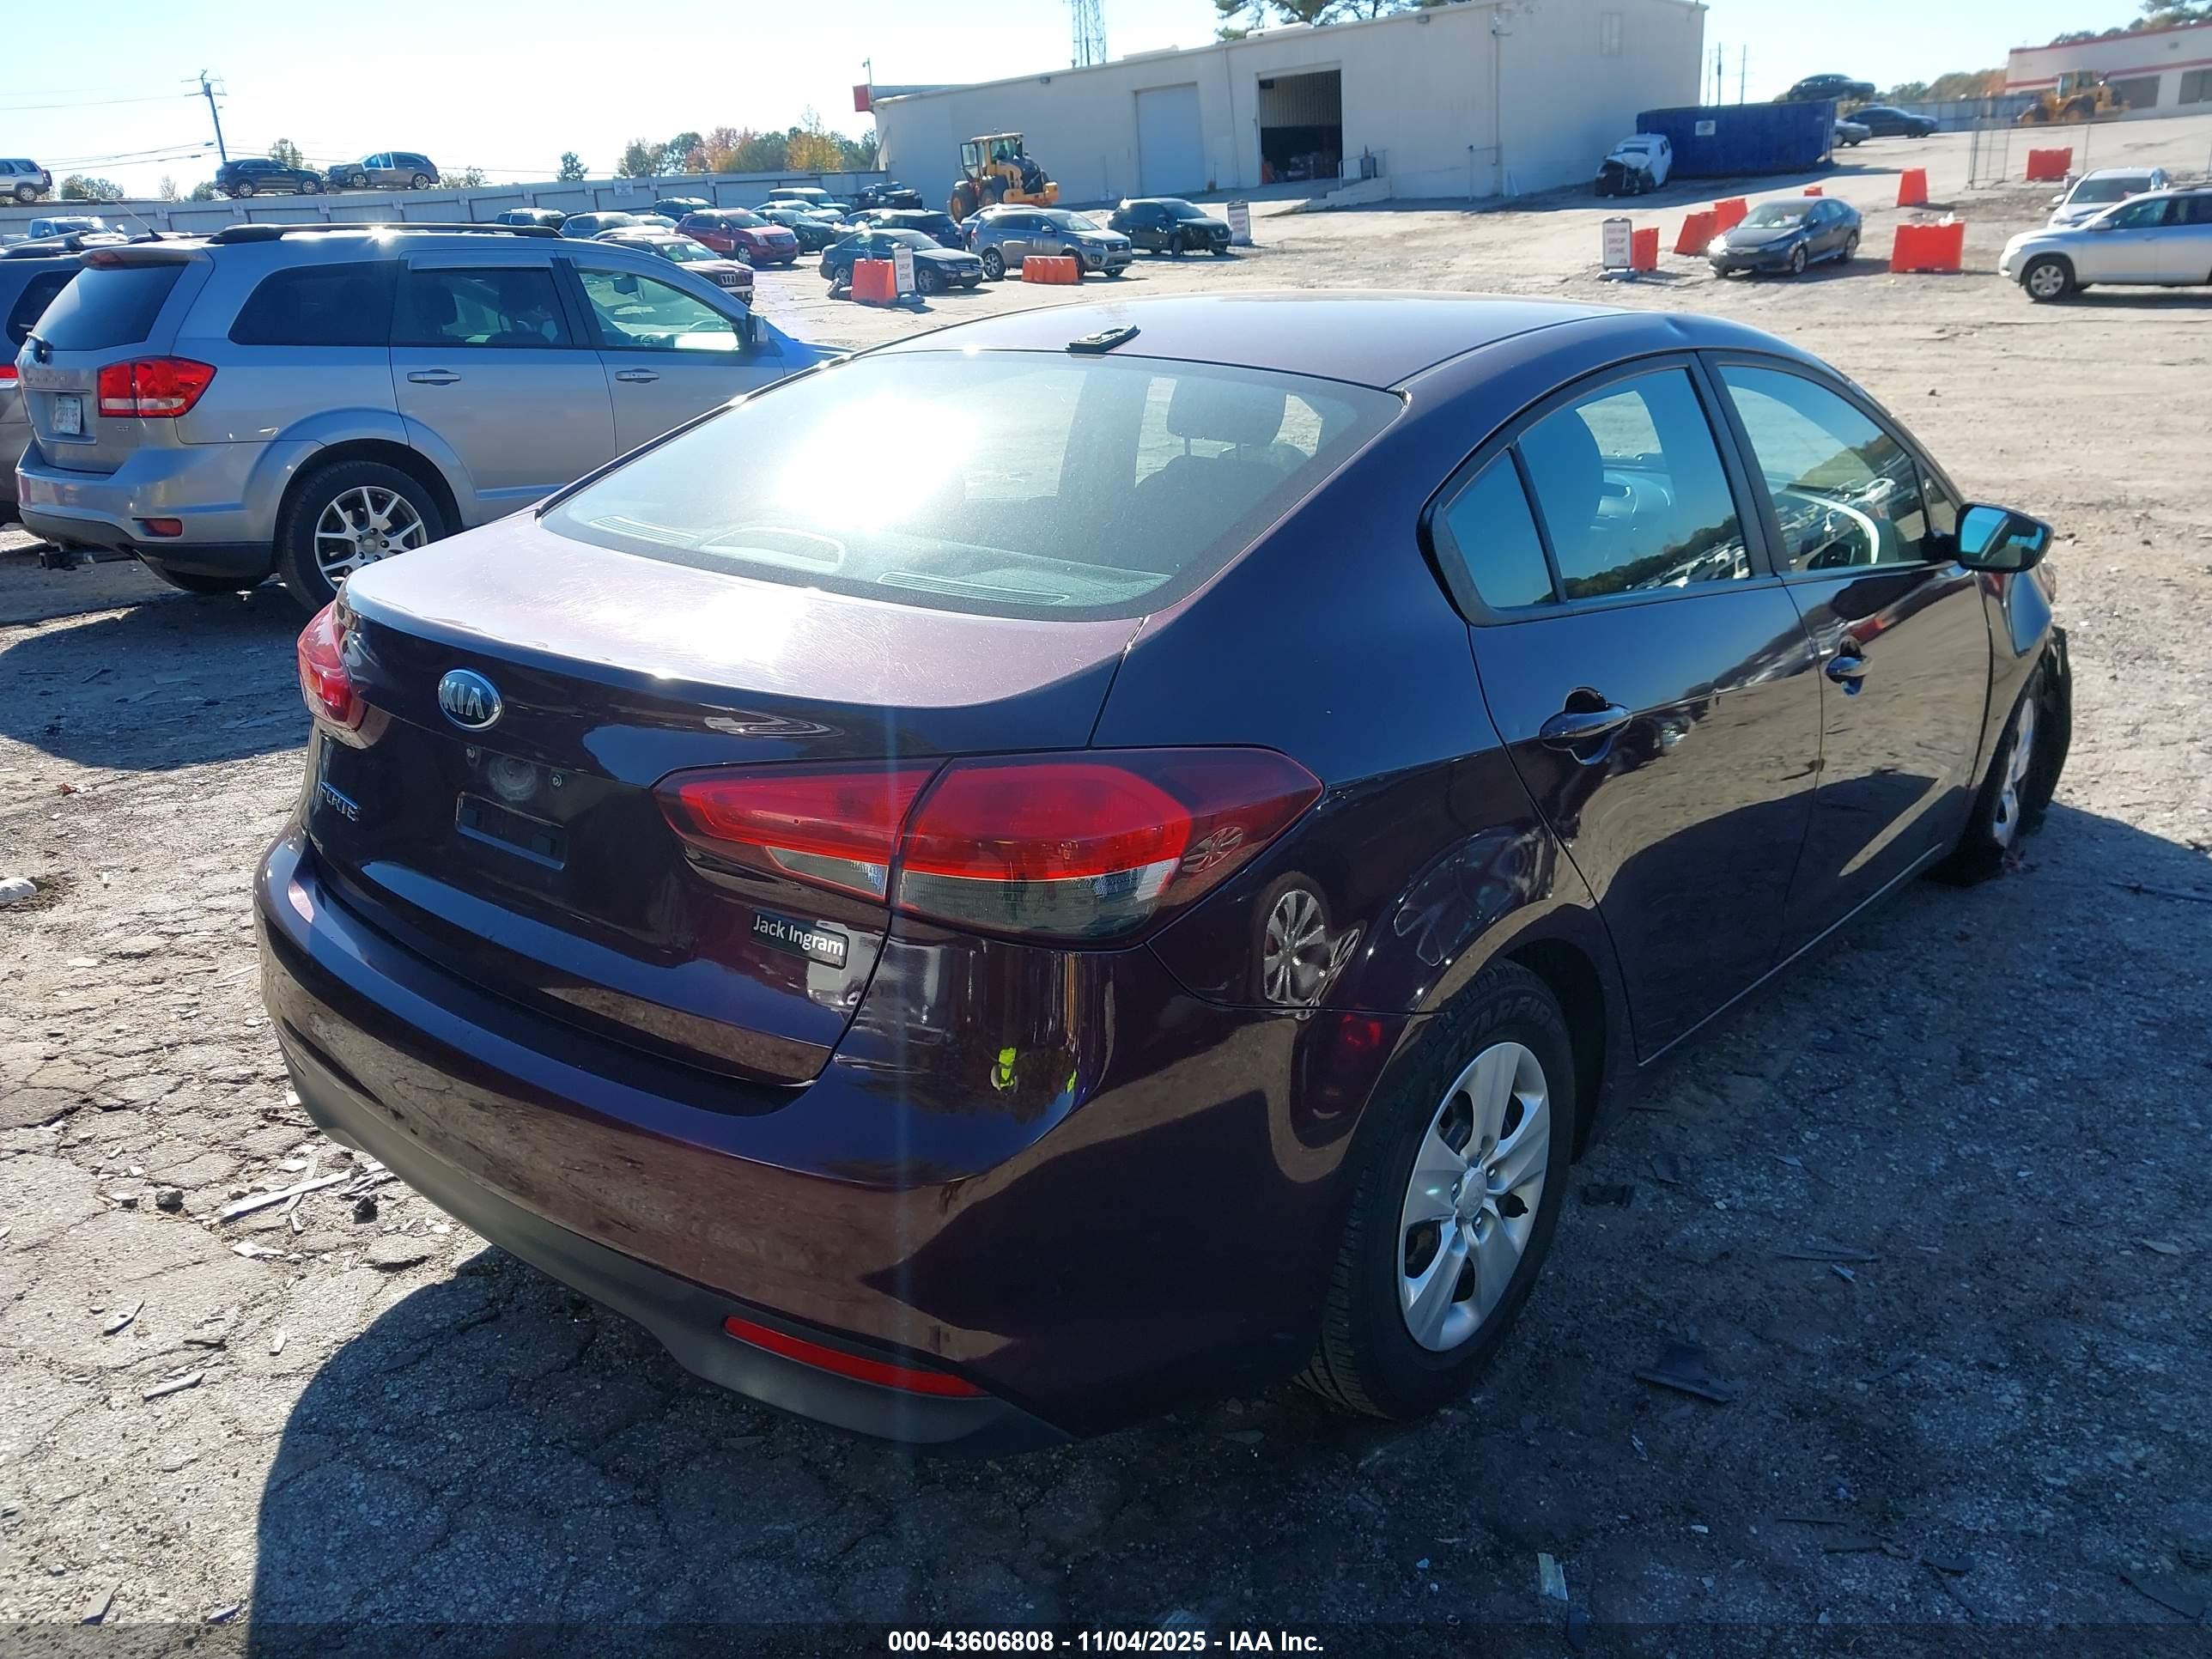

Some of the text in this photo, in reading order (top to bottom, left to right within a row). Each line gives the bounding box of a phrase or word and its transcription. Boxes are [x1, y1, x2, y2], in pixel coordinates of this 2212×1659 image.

[443, 679, 485, 719] KIA
[753, 915, 843, 957] Jack Ingram
